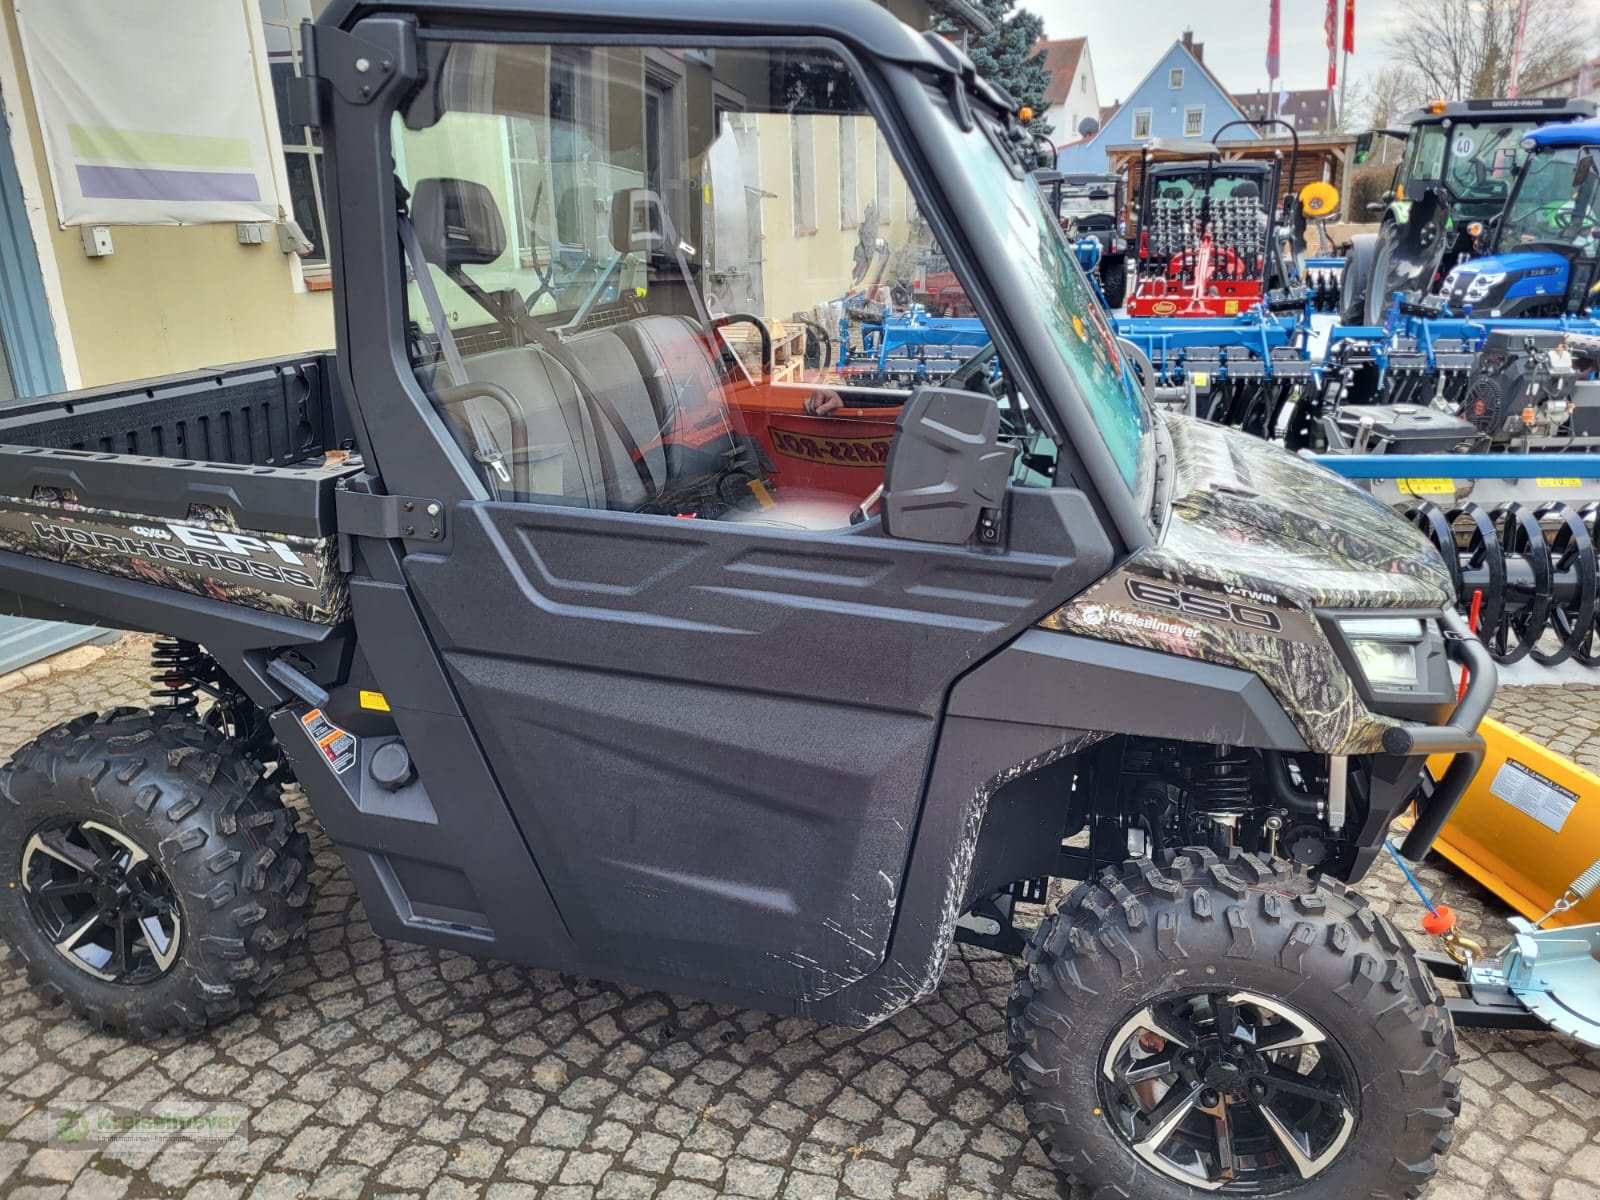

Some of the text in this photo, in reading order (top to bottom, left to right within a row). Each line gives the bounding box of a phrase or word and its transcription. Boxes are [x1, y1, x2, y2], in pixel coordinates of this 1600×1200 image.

[1456, 140, 1471, 153] 40
[166, 524, 306, 567] EFI
[1124, 578, 1284, 633] 650
[1223, 585, 1278, 603] V-TWIN
[1108, 610, 1200, 638] Kreiselmeyer
